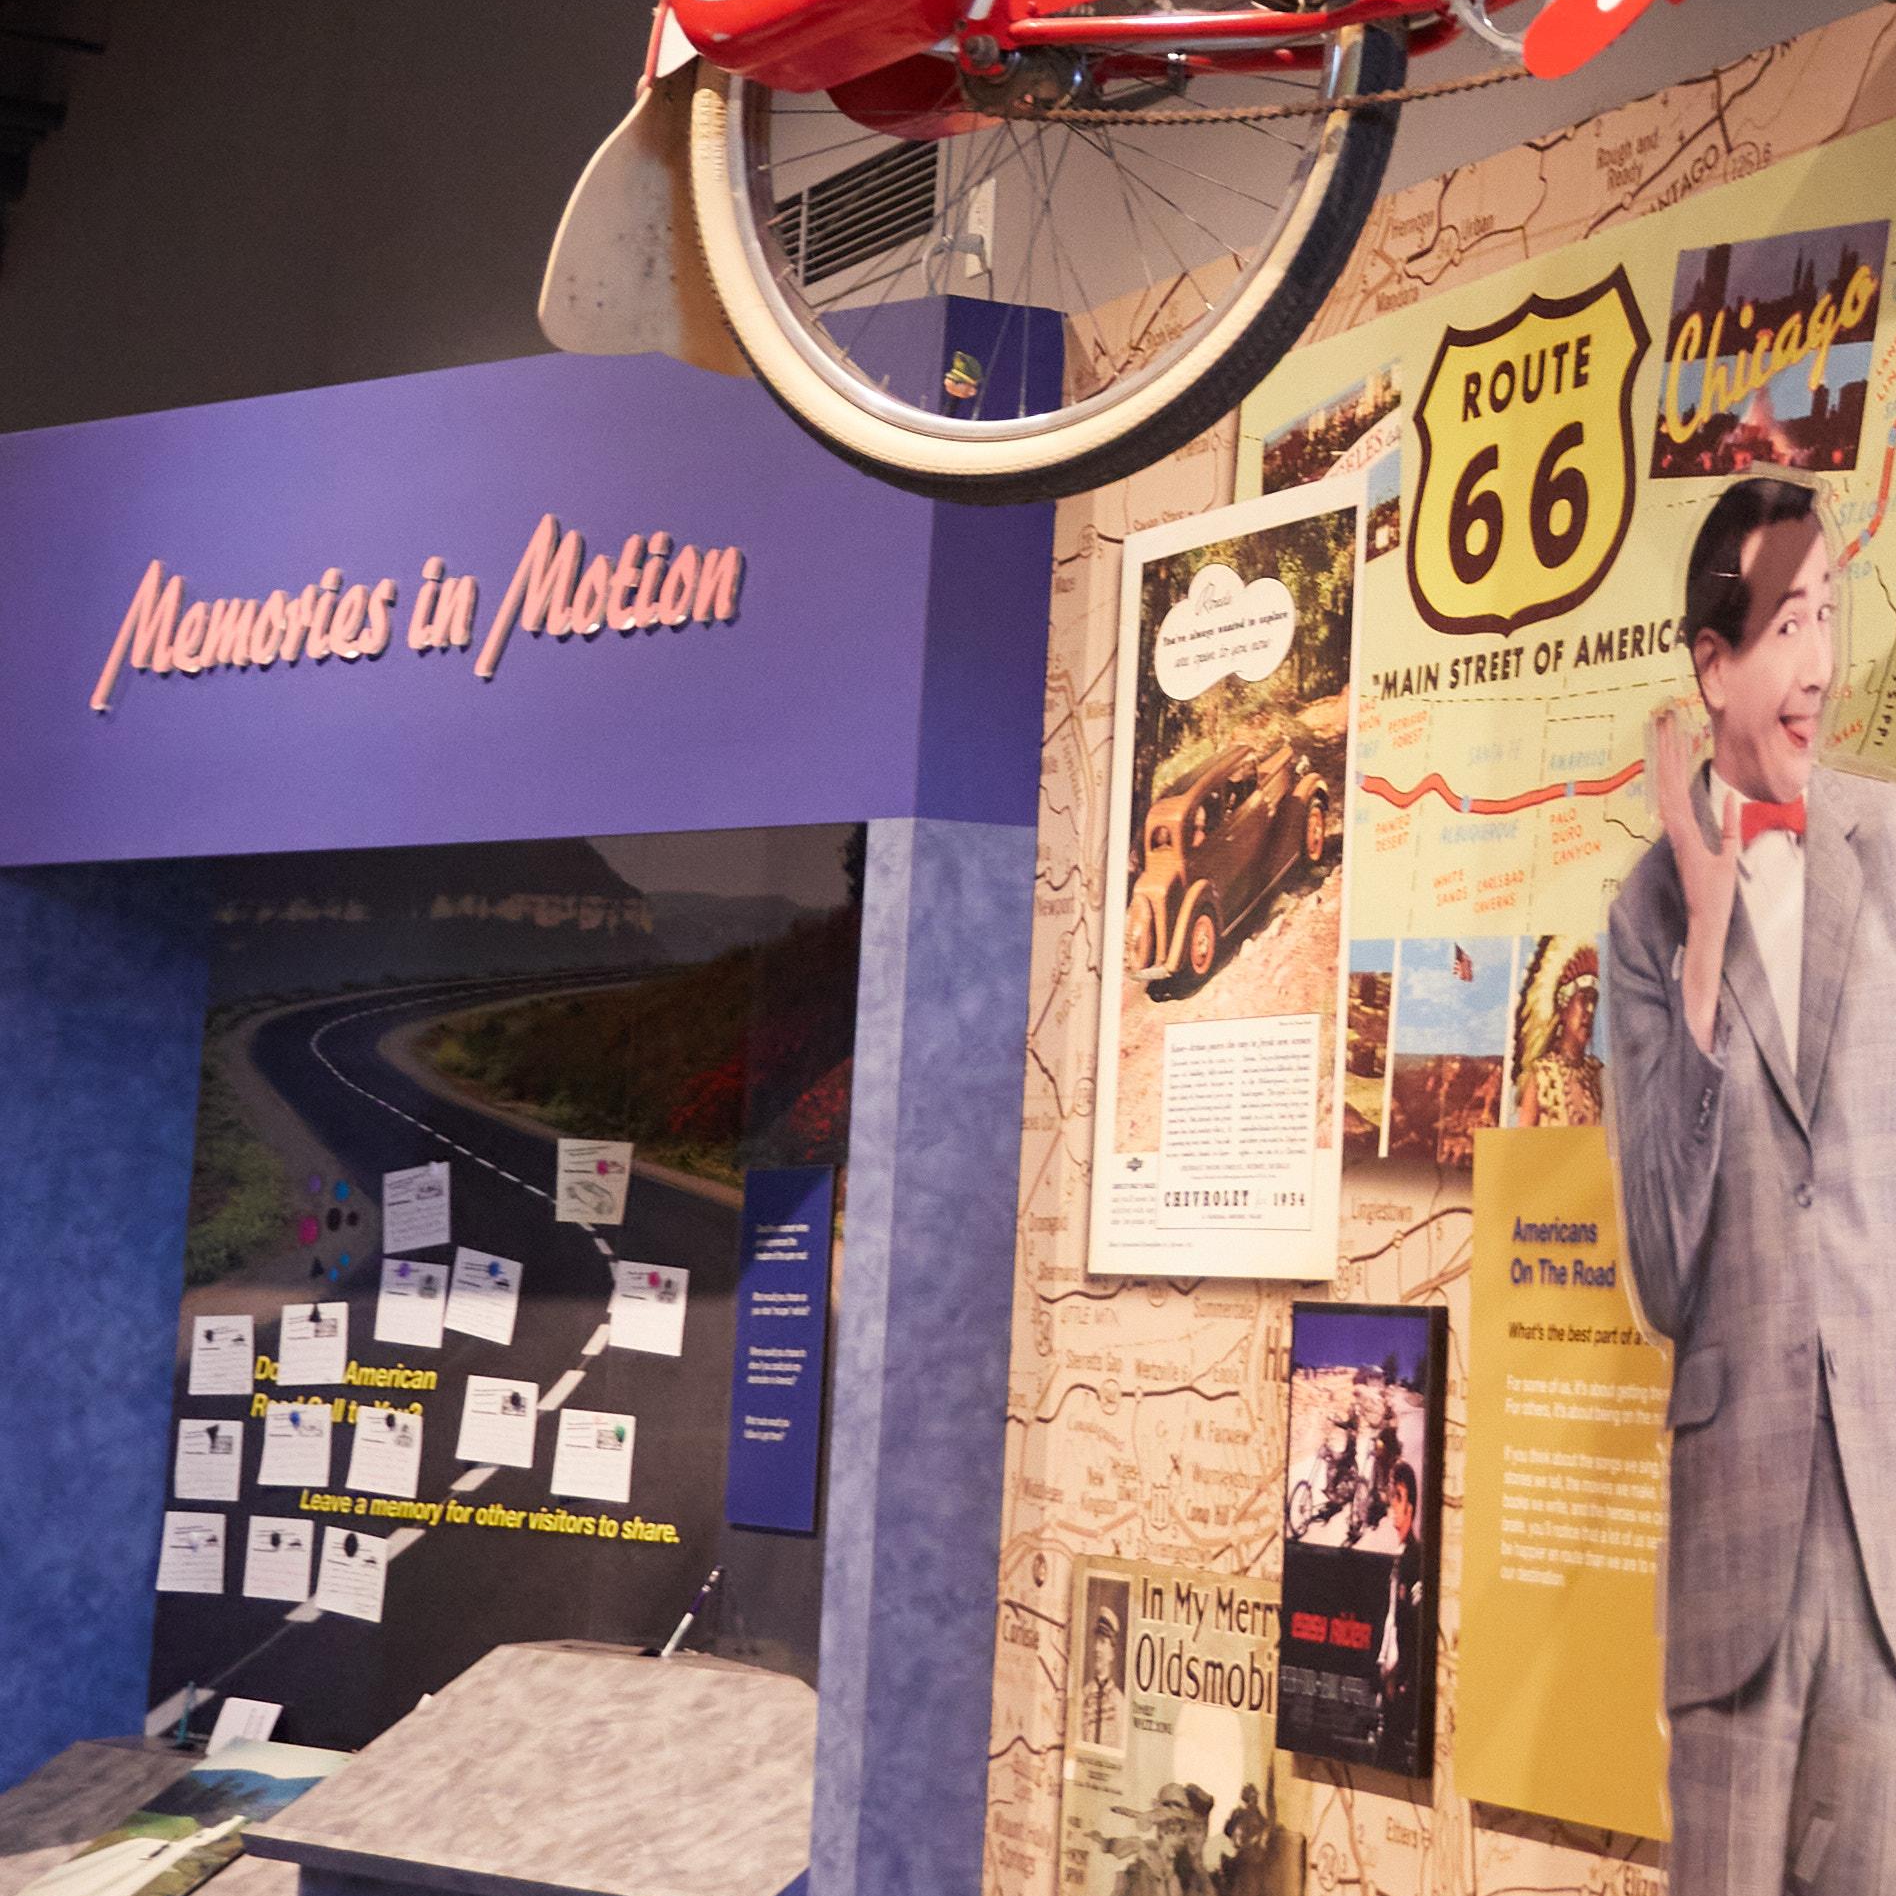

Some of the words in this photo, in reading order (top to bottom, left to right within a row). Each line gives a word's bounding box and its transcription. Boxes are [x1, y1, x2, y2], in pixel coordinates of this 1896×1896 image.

[1462, 334, 1591, 423] ROUTE
[1664, 264, 1875, 443] Chicago
[1448, 419, 1590, 584] 66
[91, 560, 397, 710] Memories
[408, 556, 477, 649] in
[474, 514, 742, 676] Motion
[1371, 663, 1442, 703] "MAIN
[1449, 649, 1529, 689] STREET
[1534, 642, 1564, 677] OF
[1164, 1190, 1249, 1207] CHEVROLET
[1512, 1217, 1597, 1244] Americans
[1510, 1258, 1533, 1286] On
[1540, 1258, 1567, 1285] The
[1573, 1261, 1616, 1287] Road
[1508, 1323, 1544, 1341] What's
[1547, 1324, 1565, 1341] the
[1568, 1325, 1592, 1342] best
[344, 1362, 437, 1390] American
[300, 1490, 350, 1513] Leave
[356, 1499, 366, 1514] a
[371, 1501, 443, 1526] memory
[446, 1501, 473, 1524] for
[475, 1505, 524, 1530] other
[528, 1509, 595, 1536] visitors
[597, 1517, 618, 1537] to
[622, 1518, 680, 1543] share.
[1142, 1578, 1163, 1620] In
[1175, 1581, 1209, 1642] My
[1136, 1633, 1272, 1713] Oldsmobi
